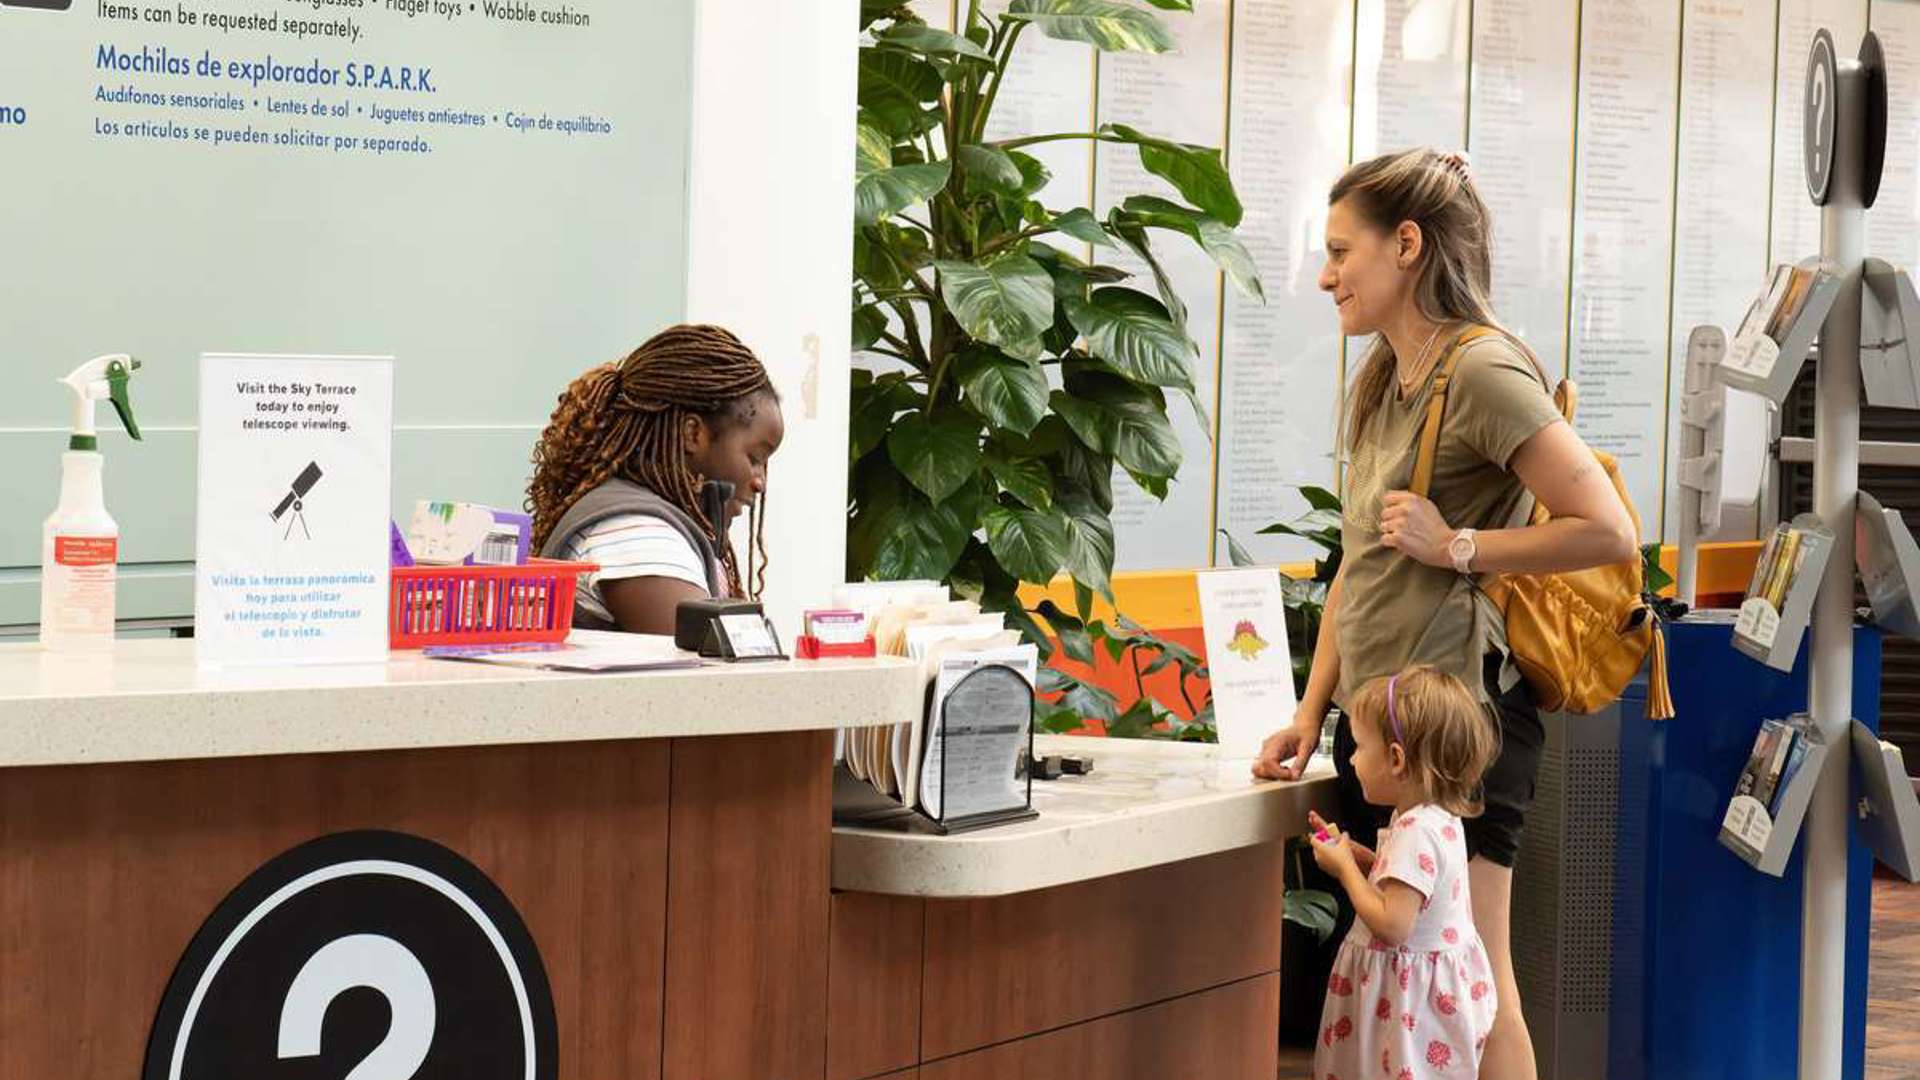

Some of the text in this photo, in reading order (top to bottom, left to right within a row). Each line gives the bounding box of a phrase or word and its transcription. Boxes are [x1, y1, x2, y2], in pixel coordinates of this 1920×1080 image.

[97, 0, 364, 44] Items can be requested separately.
[434, 0, 462, 21] toys
[484, 2, 536, 22] Wobble
[540, 7, 590, 27] cushion
[96, 44, 437, 93] Mochilas de explorador S.P.A.R.K.
[170, 91, 244, 112] sensoriales
[267, 96, 308, 115] Lentes
[311, 98, 327, 117] de
[331, 100, 349, 118] sol
[370, 103, 425, 125] Juguetes
[538, 112, 555, 131] de
[555, 116, 612, 135] equilibrio
[95, 117, 119, 135] Los
[194, 126, 209, 141] se
[214, 124, 269, 146] pueden
[273, 127, 330, 148] solicitar
[334, 136, 358, 152] por
[363, 135, 432, 155] separado.
[236, 382, 358, 397] Visit the Sky Terrace
[256, 400, 340, 415] today to enjoy
[242, 418, 352, 432] telescope viewing.
[246, 592, 267, 605] hoy
[270, 593, 298, 605] para
